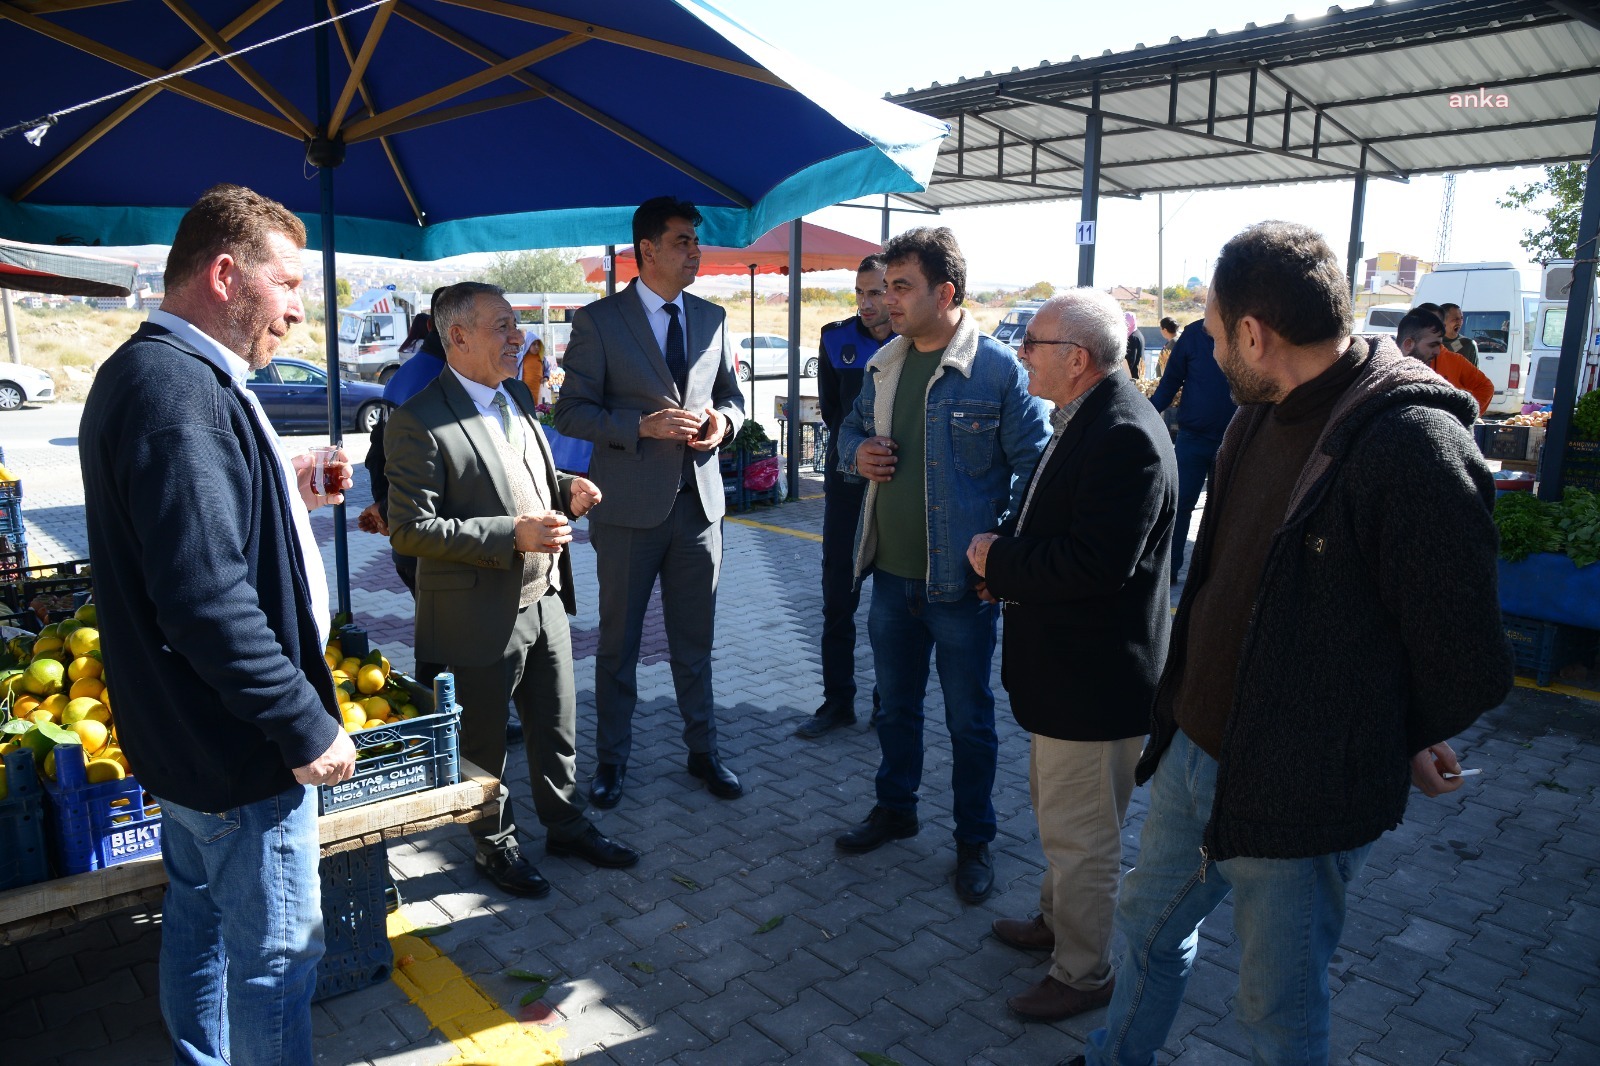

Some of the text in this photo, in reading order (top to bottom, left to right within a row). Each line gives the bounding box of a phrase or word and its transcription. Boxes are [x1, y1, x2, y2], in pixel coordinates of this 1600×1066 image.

[1078, 224, 1092, 242] 11
[332, 764, 425, 795] BEKTAŞ OLUK
[333, 774, 426, 804] NO:6 KIRŞEHİR
[111, 839, 155, 857] NO:6
